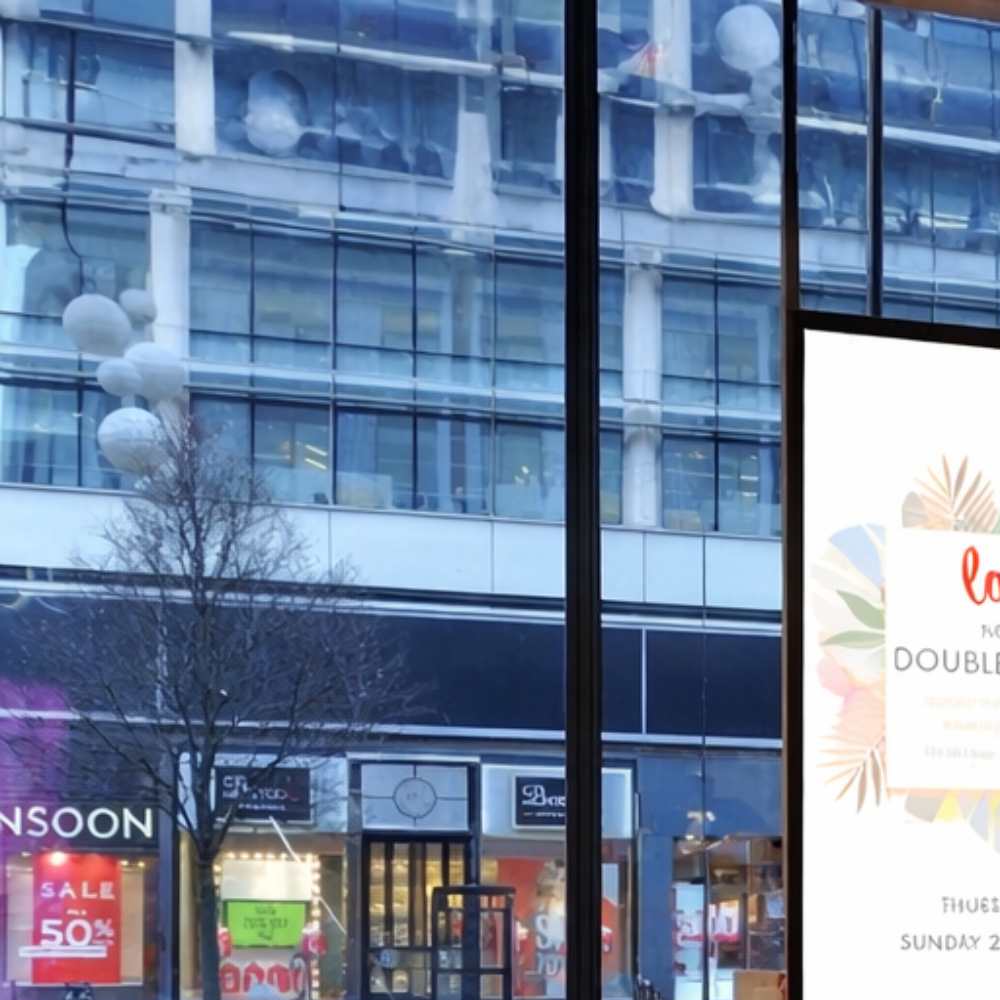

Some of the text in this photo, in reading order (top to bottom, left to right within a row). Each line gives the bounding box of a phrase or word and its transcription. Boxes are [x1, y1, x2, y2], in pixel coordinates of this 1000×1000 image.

[0, 806, 153, 839] NSOON
[41, 881, 115, 900] SALE
[900, 933, 981, 951] SUNDAY
